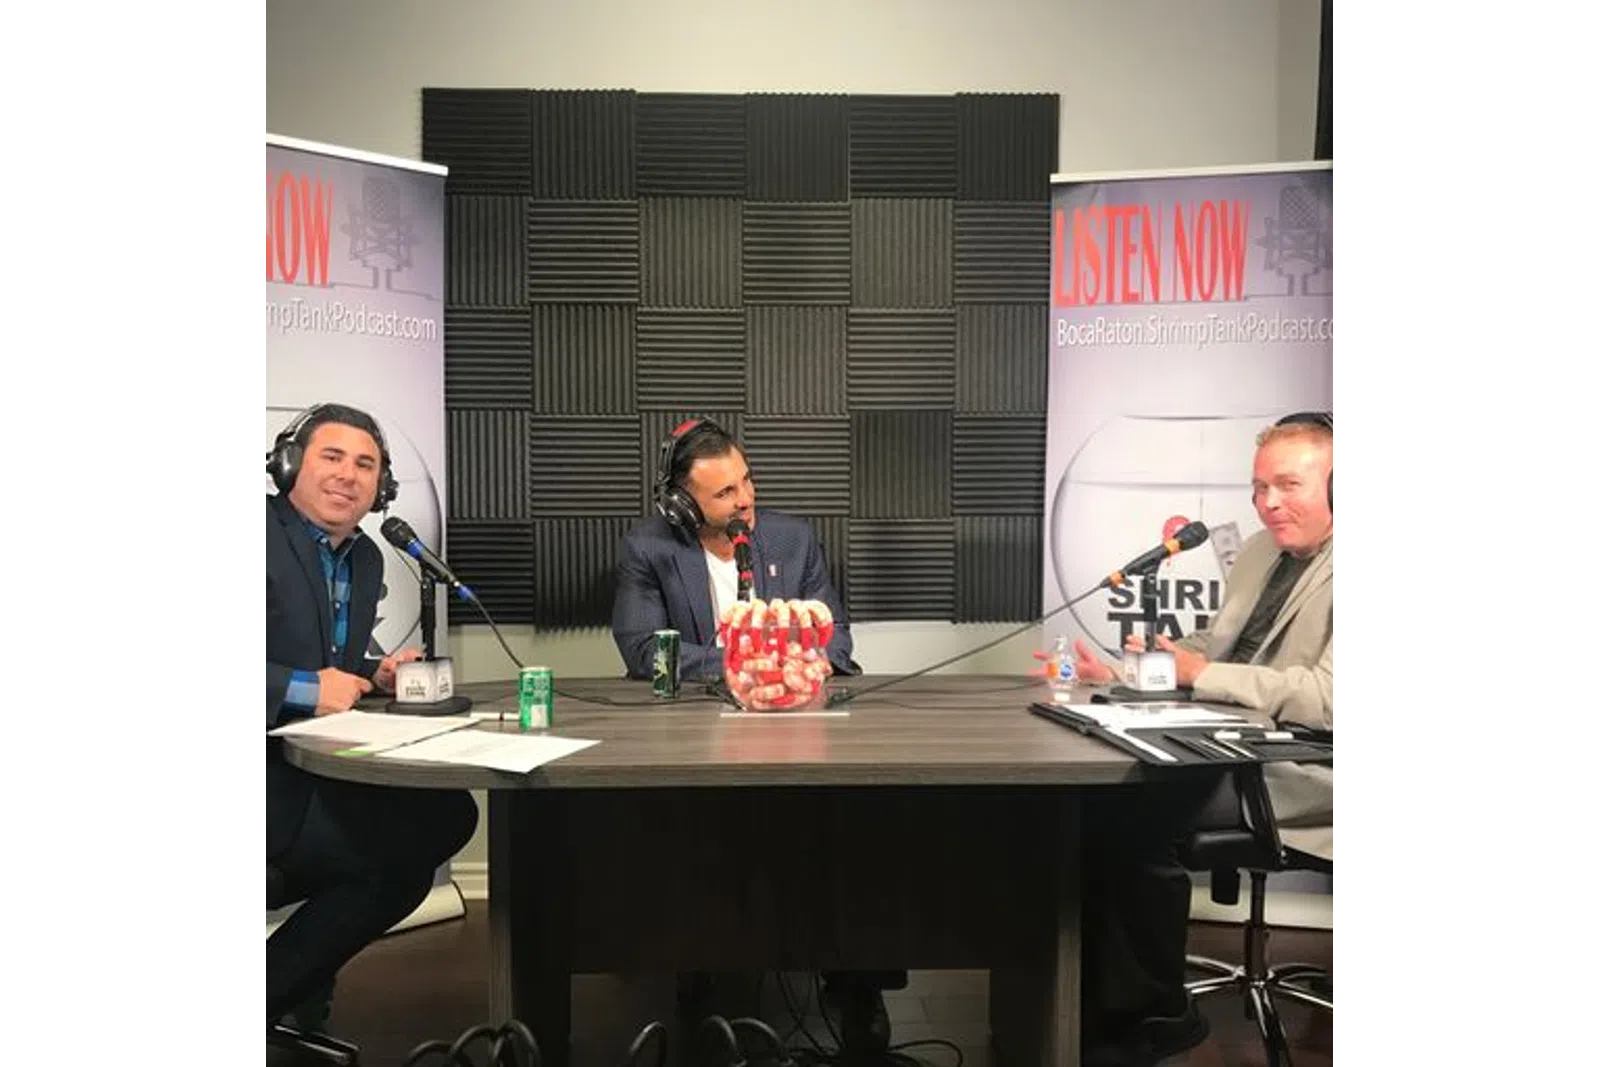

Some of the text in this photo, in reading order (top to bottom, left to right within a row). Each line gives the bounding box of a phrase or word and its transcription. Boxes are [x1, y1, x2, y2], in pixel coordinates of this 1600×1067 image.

[265, 170, 334, 288] OW
[1055, 199, 1249, 307] LISTEN NOW
[1107, 612, 1209, 652] TA
